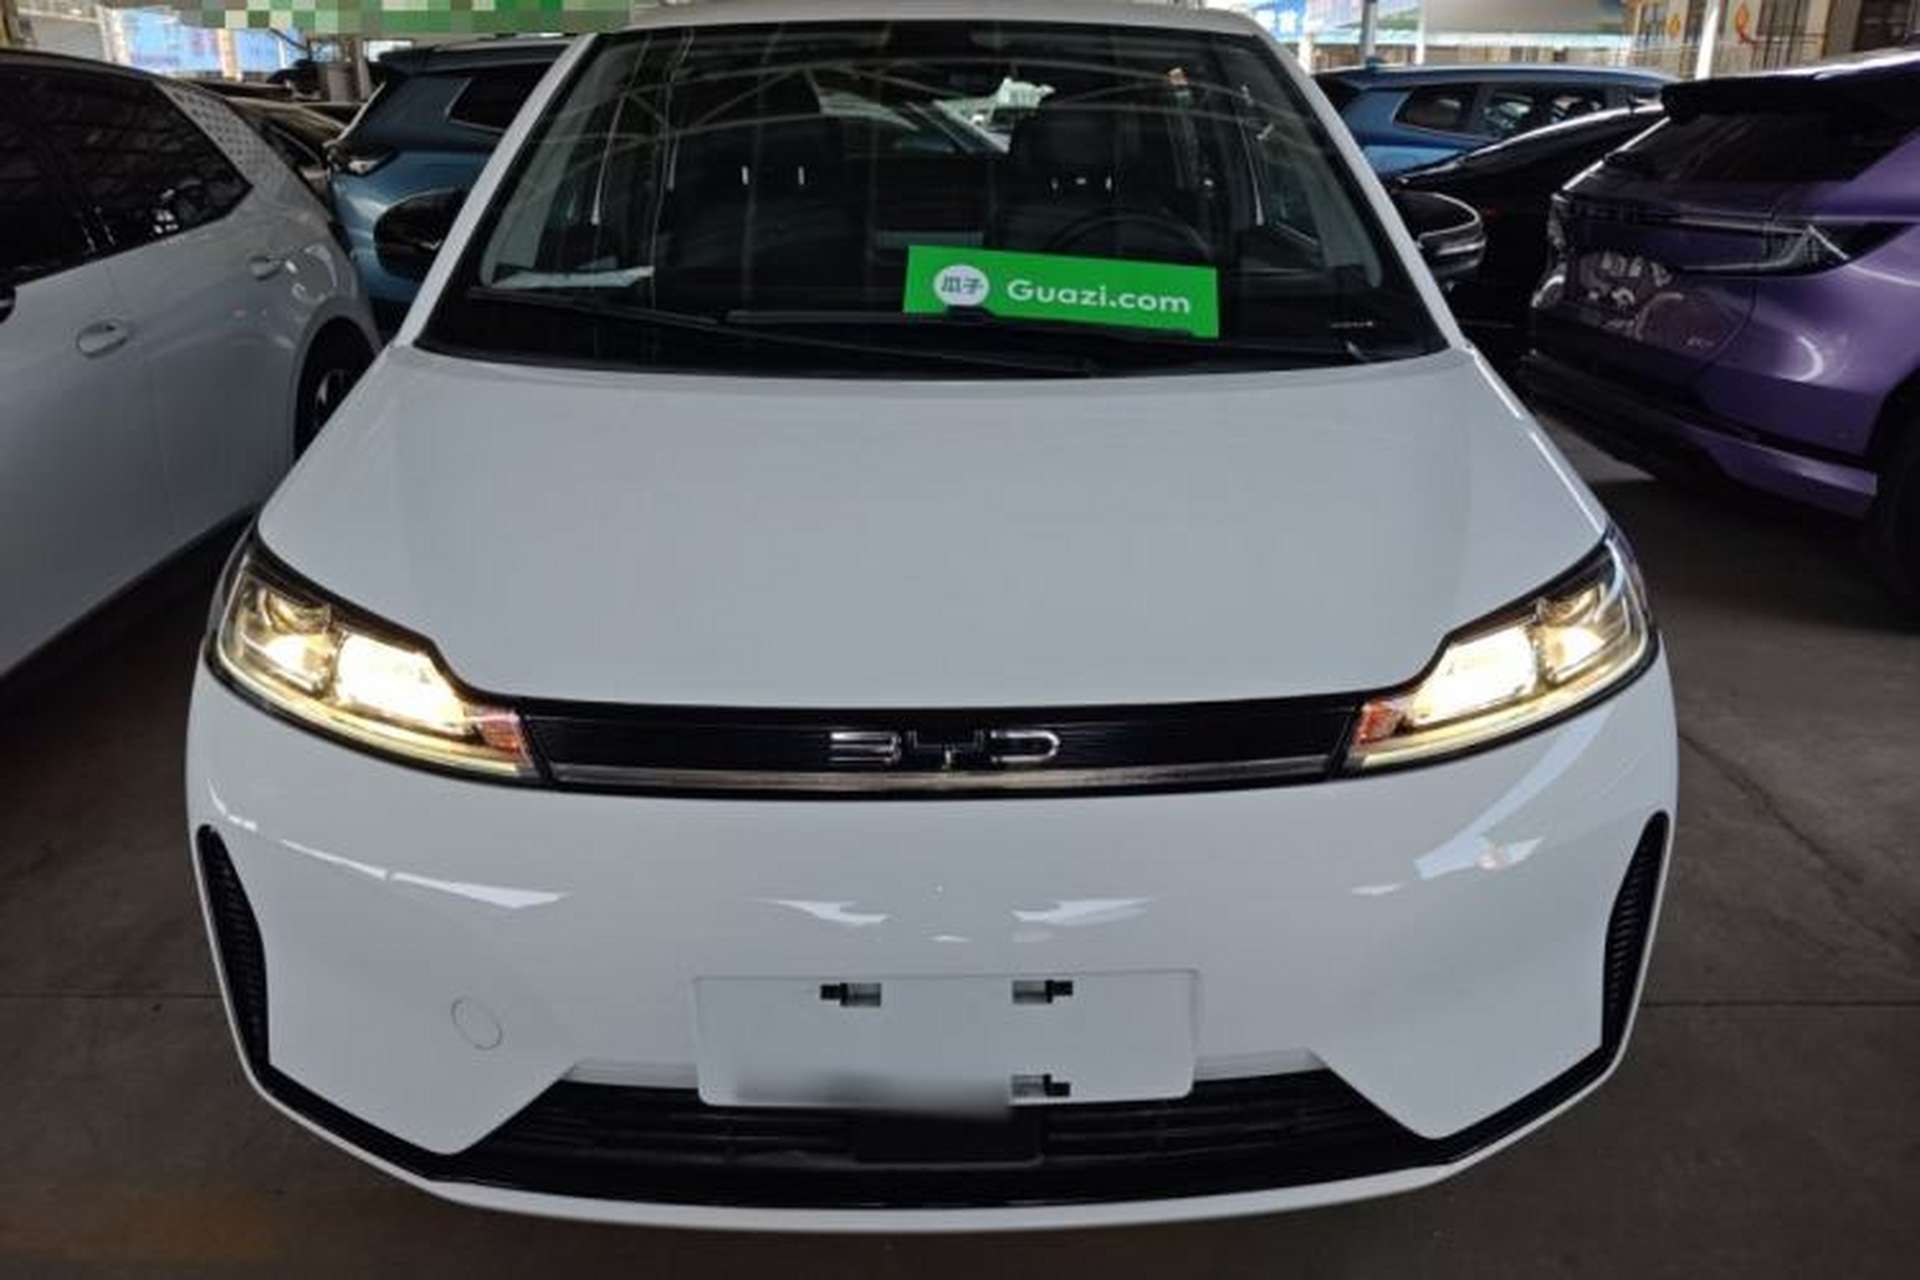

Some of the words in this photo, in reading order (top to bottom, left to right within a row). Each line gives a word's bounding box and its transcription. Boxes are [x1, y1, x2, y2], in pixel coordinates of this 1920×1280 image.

[941, 275, 984, 295] 瓜子
[1007, 279, 1190, 313] Guazi.com
[829, 729, 1061, 769] BYD
